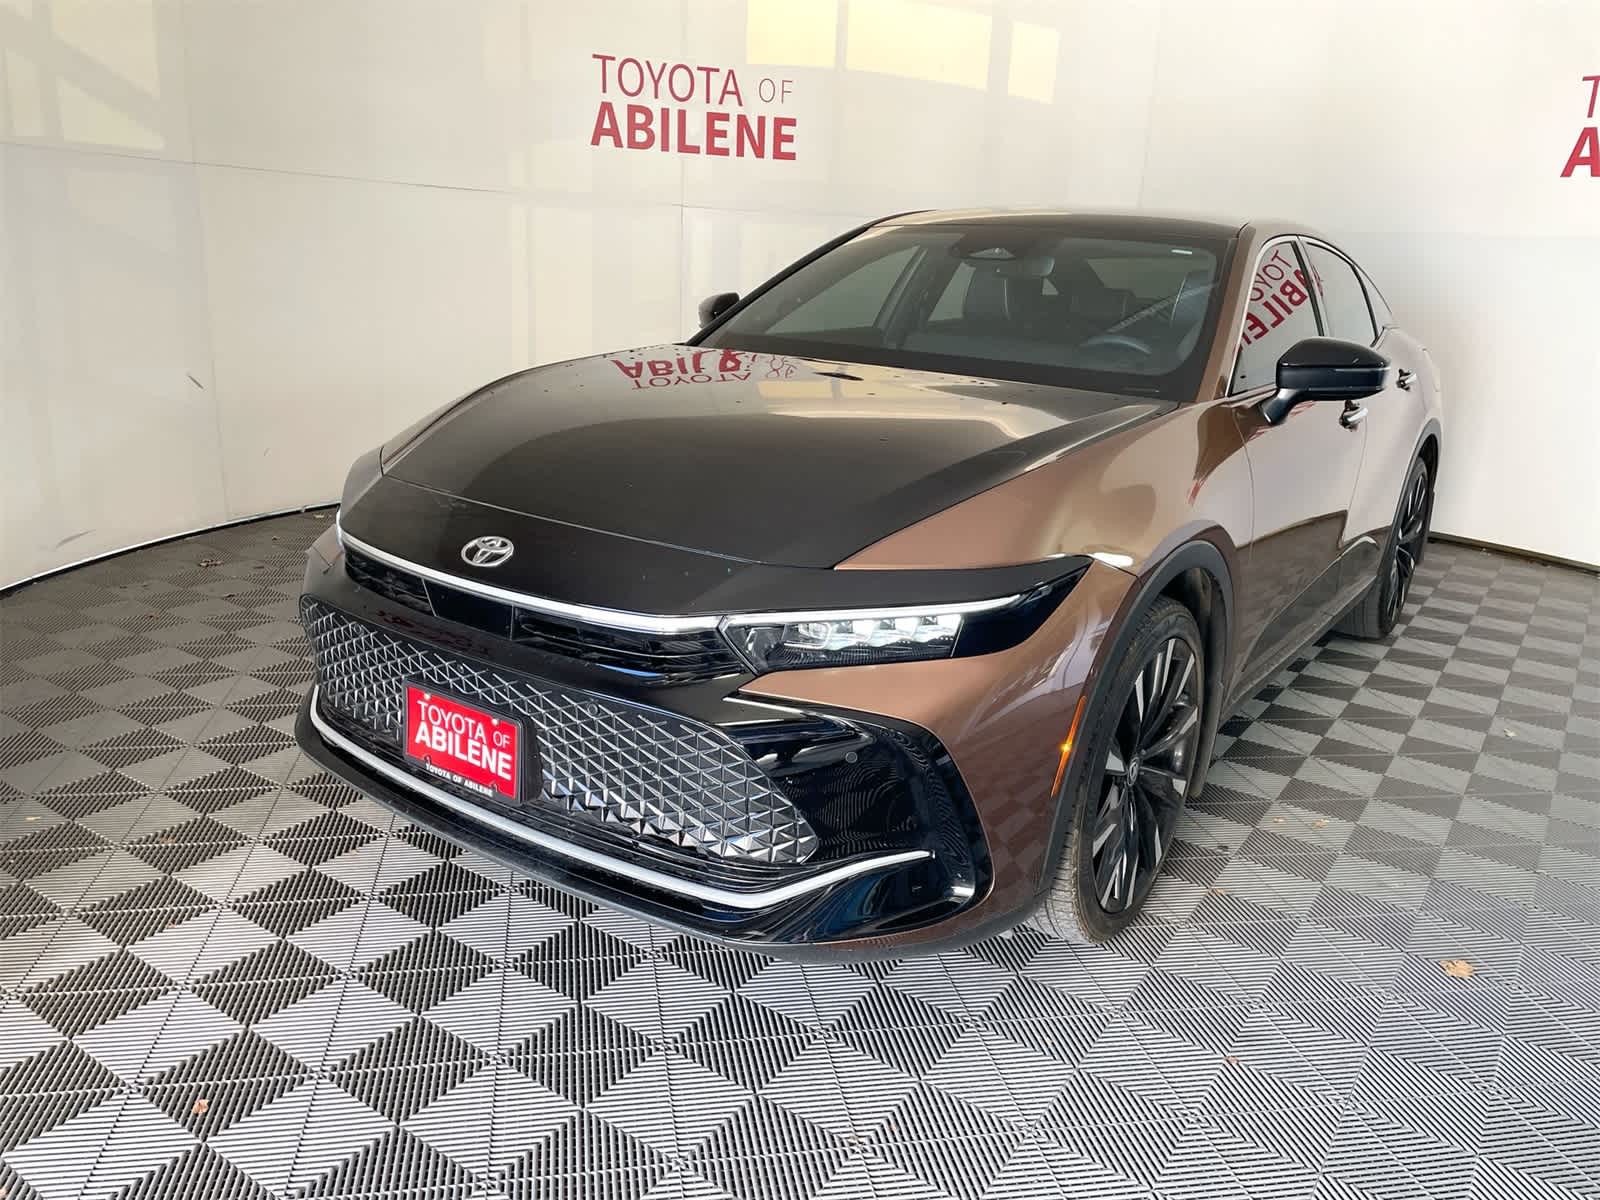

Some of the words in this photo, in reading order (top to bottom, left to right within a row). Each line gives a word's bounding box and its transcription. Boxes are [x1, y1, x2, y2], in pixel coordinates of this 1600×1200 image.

[592, 53, 743, 107] TOYOTA
[758, 78, 793, 104] OF
[590, 101, 797, 161] ABILENE
[415, 721, 512, 781] ABILENE
[417, 700, 487, 745] TOYOTA
[493, 731, 511, 748] OF
[425, 763, 451, 780] TOYOTA
[452, 774, 463, 784] OF
[464, 780, 493, 798] ABILENE
